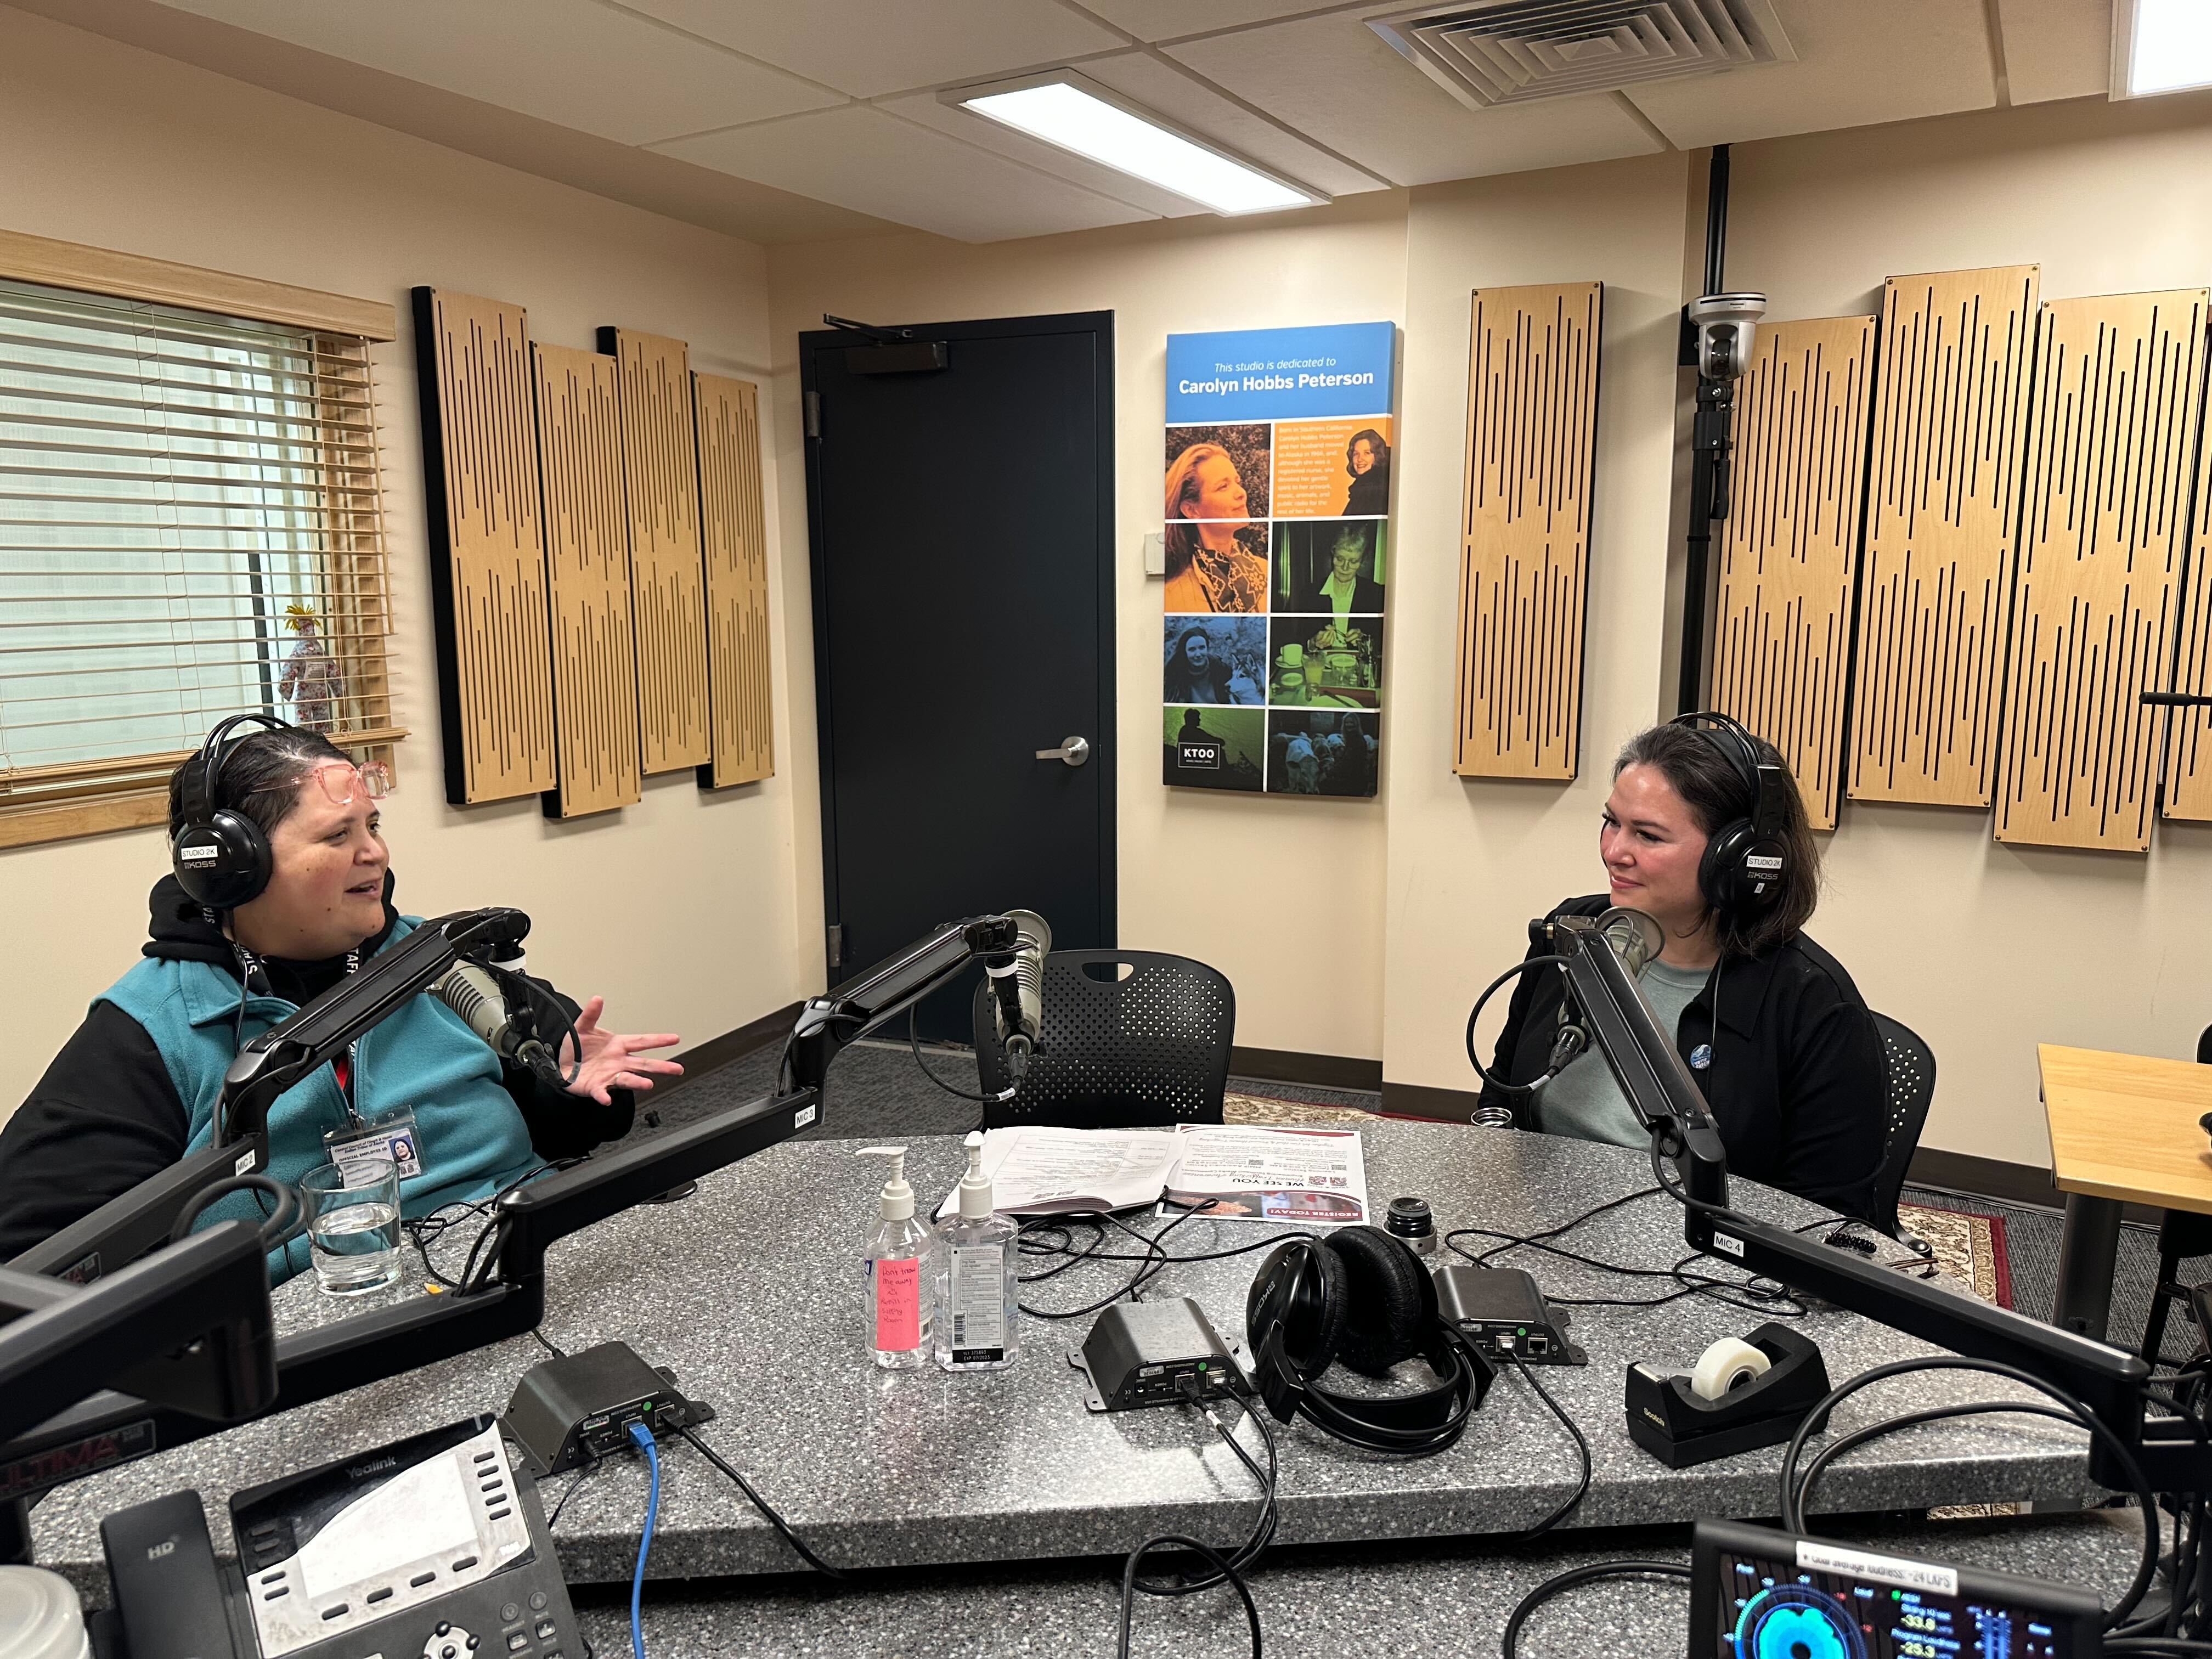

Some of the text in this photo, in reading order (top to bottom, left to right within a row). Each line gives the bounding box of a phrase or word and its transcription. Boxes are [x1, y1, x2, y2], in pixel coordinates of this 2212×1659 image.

[1215, 357, 1336, 373] This studio is dedicated to
[1179, 371, 1374, 396] Carolyn Hobbs Peterson
[1184, 748, 1215, 759] KTOO
[182, 849, 205, 857] STUDIO
[189, 860, 216, 868] KOSS
[1748, 858, 1773, 866] STUDIO
[796, 1109, 814, 1126] MIC 3
[237, 1154, 253, 1172] MIC 2
[339, 1154, 359, 1162] OFFICIAL
[1716, 1235, 1741, 1253] MIC 4
[1251, 1288, 1271, 1327] KOSS
[1644, 1407, 1664, 1426] Scotch
[345, 1455, 396, 1479] Yealink
[148, 1542, 175, 1560] HD
[1900, 1614, 1936, 1631] -33.8
